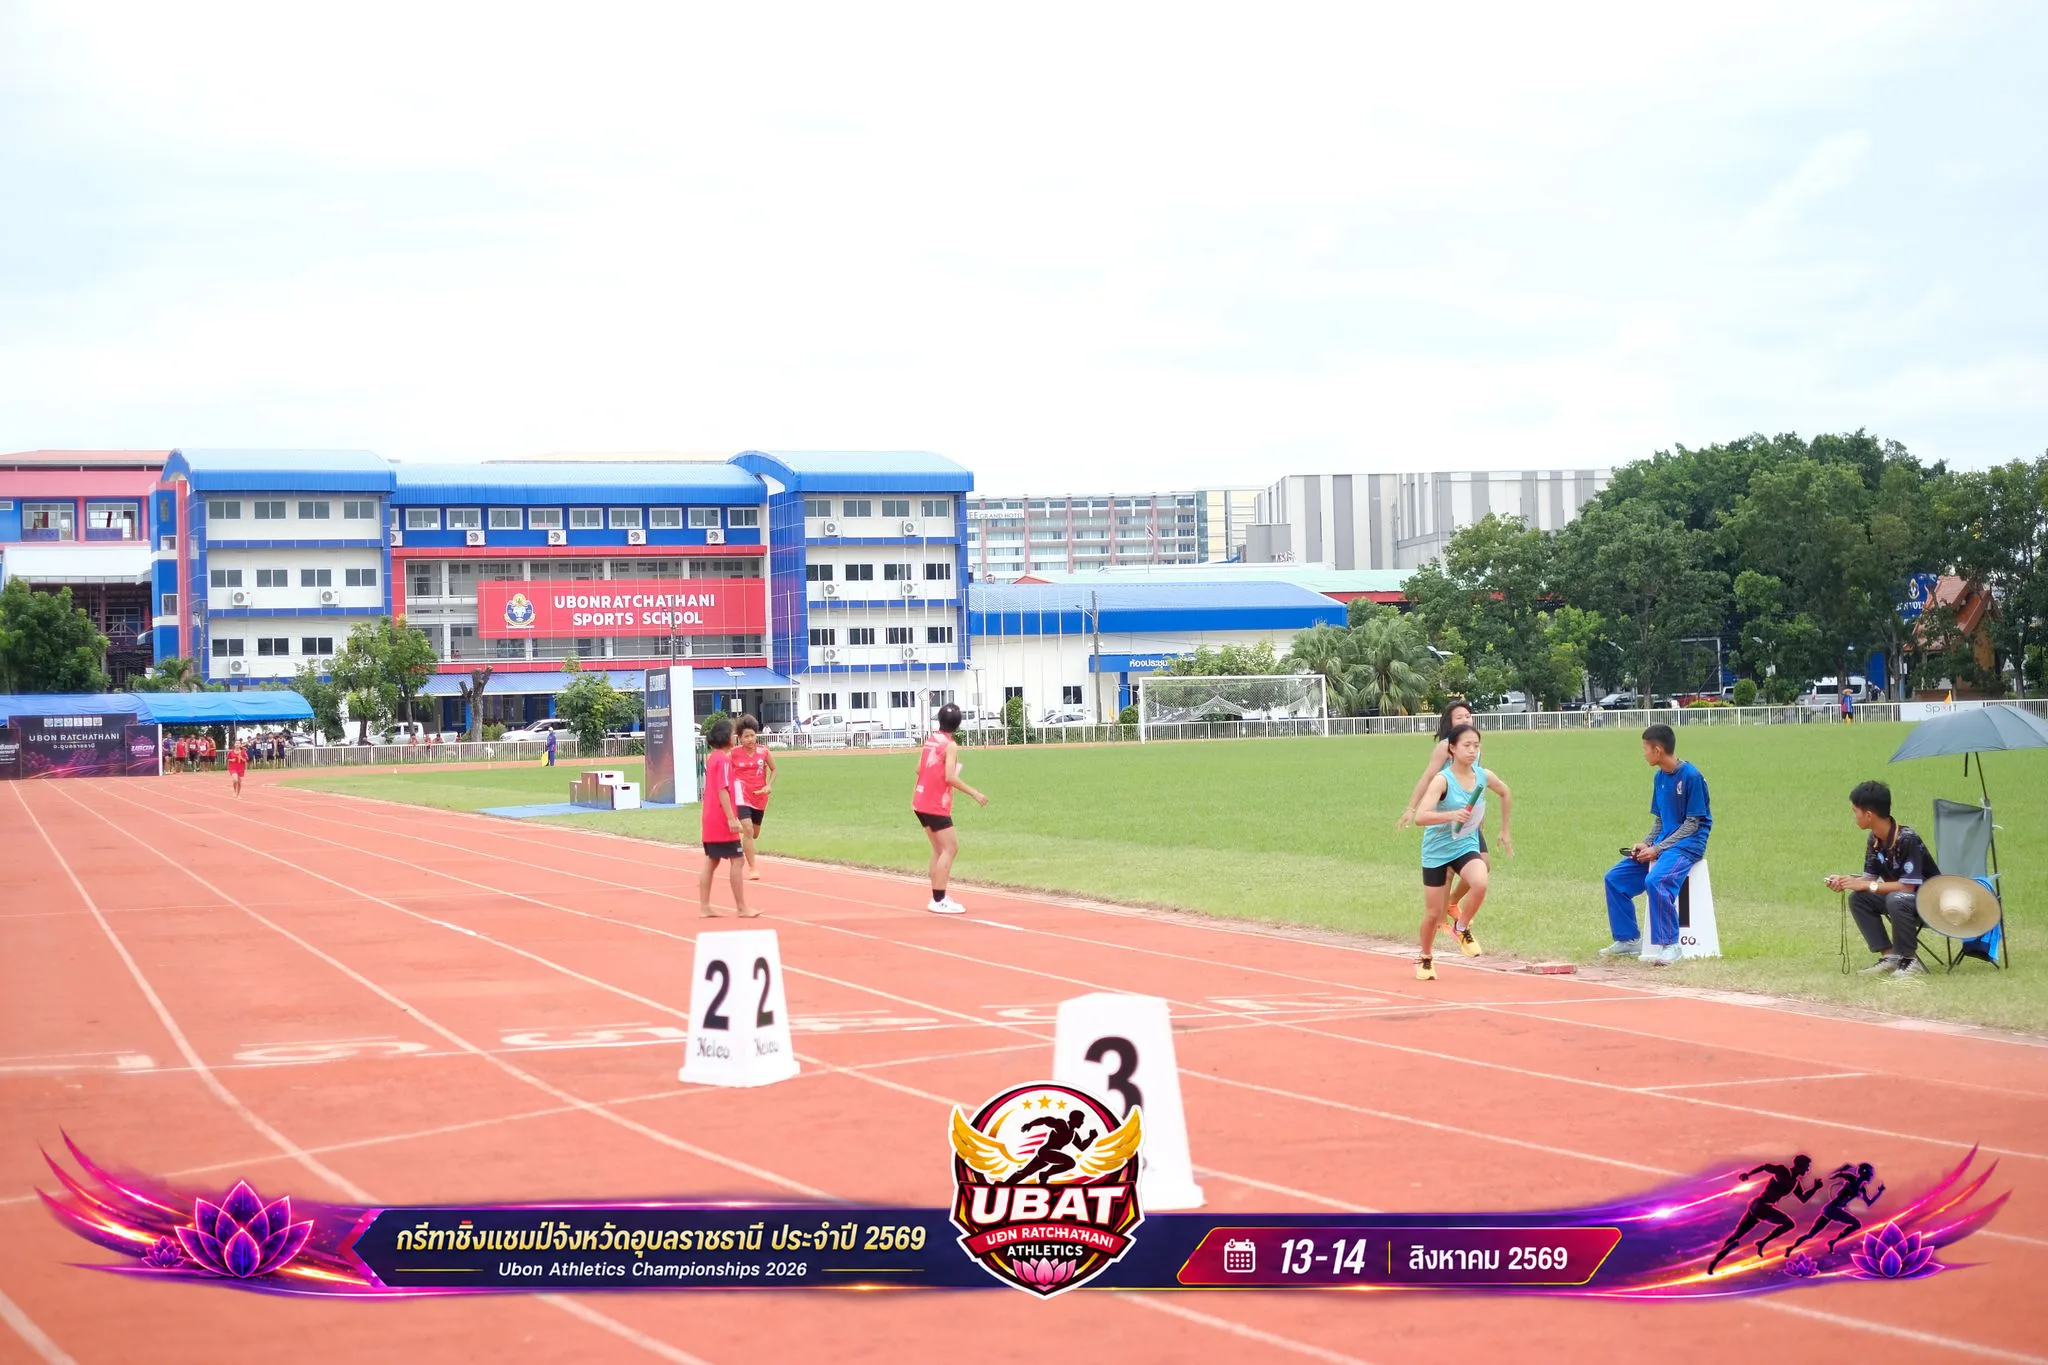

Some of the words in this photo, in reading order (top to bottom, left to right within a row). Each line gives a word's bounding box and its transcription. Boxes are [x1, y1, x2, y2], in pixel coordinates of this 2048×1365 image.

[554, 594, 715, 608] UBONRATCHATHANI
[573, 612, 634, 626] SPORTS
[643, 611, 703, 625] SCHOOL
[28, 734, 58, 742] UBON
[60, 733, 120, 741] RATCHATHANI
[702, 959, 731, 1031] 2
[753, 956, 775, 1028] 2
[1084, 1036, 1144, 1119] 3
